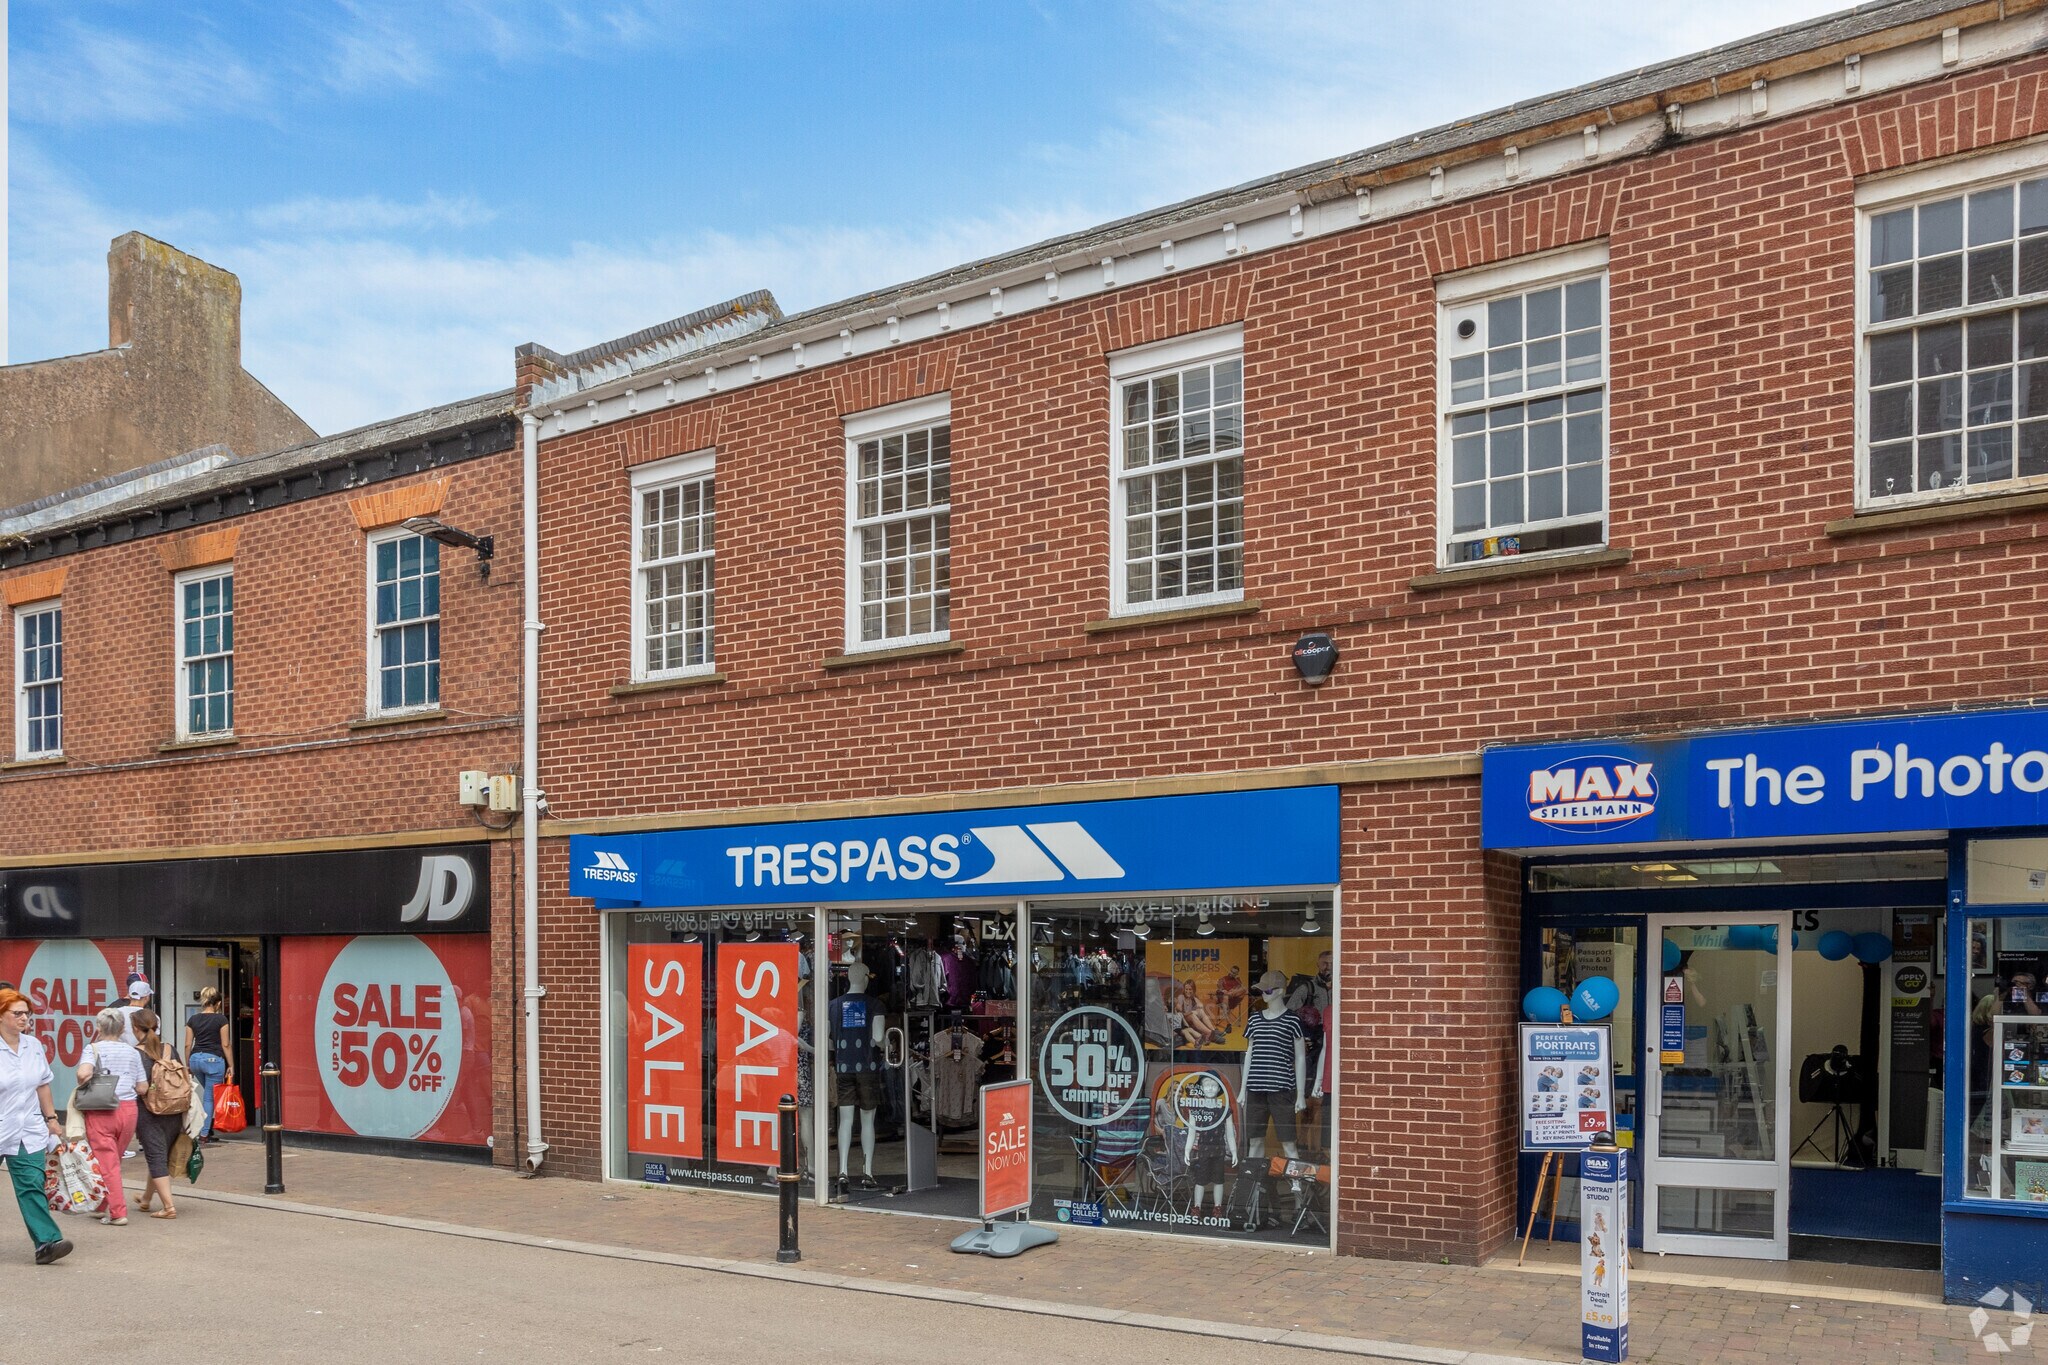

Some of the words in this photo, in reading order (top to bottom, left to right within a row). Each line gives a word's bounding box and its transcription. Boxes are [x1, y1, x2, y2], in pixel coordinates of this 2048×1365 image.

[1530, 763, 1654, 803] MAX
[1705, 753, 1826, 808] The
[1850, 741, 2048, 802] Photo
[1541, 803, 1643, 818] SPIELMANN
[400, 855, 474, 922] JD
[634, 913, 695, 923] CAMPING
[710, 911, 804, 922] SNOWSPORT
[982, 920, 1016, 941] DLX
[1173, 948, 1219, 962] HAPPY
[1577, 949, 1612, 957] Passport
[1173, 964, 1220, 974] CAMPERS
[30, 978, 107, 1016] SALE
[1582, 990, 1600, 1011] MAX
[332, 983, 442, 1030] SALE
[332, 1030, 340, 1048] TO
[1073, 1029, 1092, 1042] UP
[1092, 1029, 1107, 1042] TO
[644, 959, 685, 1142] SALE
[1535, 1042, 1596, 1050] PORTRAITS
[332, 1052, 340, 1072] UP
[337, 1031, 442, 1090] 50%
[736, 959, 780, 1151] SALE
[1051, 1044, 1131, 1088] 50%
[1107, 1074, 1132, 1089] OFF
[1062, 1089, 1120, 1104] CAMPING
[1584, 1117, 1605, 1128] £9.99
[988, 1125, 1026, 1154] SALE
[987, 1154, 1011, 1172] NOW
[1012, 1151, 1026, 1165] ON
[670, 1167, 754, 1184] www.trespass.com
[1072, 1202, 1091, 1211] CLICK
[1091, 1203, 1098, 1211] &
[1072, 1209, 1100, 1218] COLLECT
[1108, 1208, 1231, 1228] www.trespass.com
[1587, 1290, 1610, 1298] Portrait
[1586, 1312, 1612, 1323] £5.99
[1587, 1334, 1611, 1343] Available
